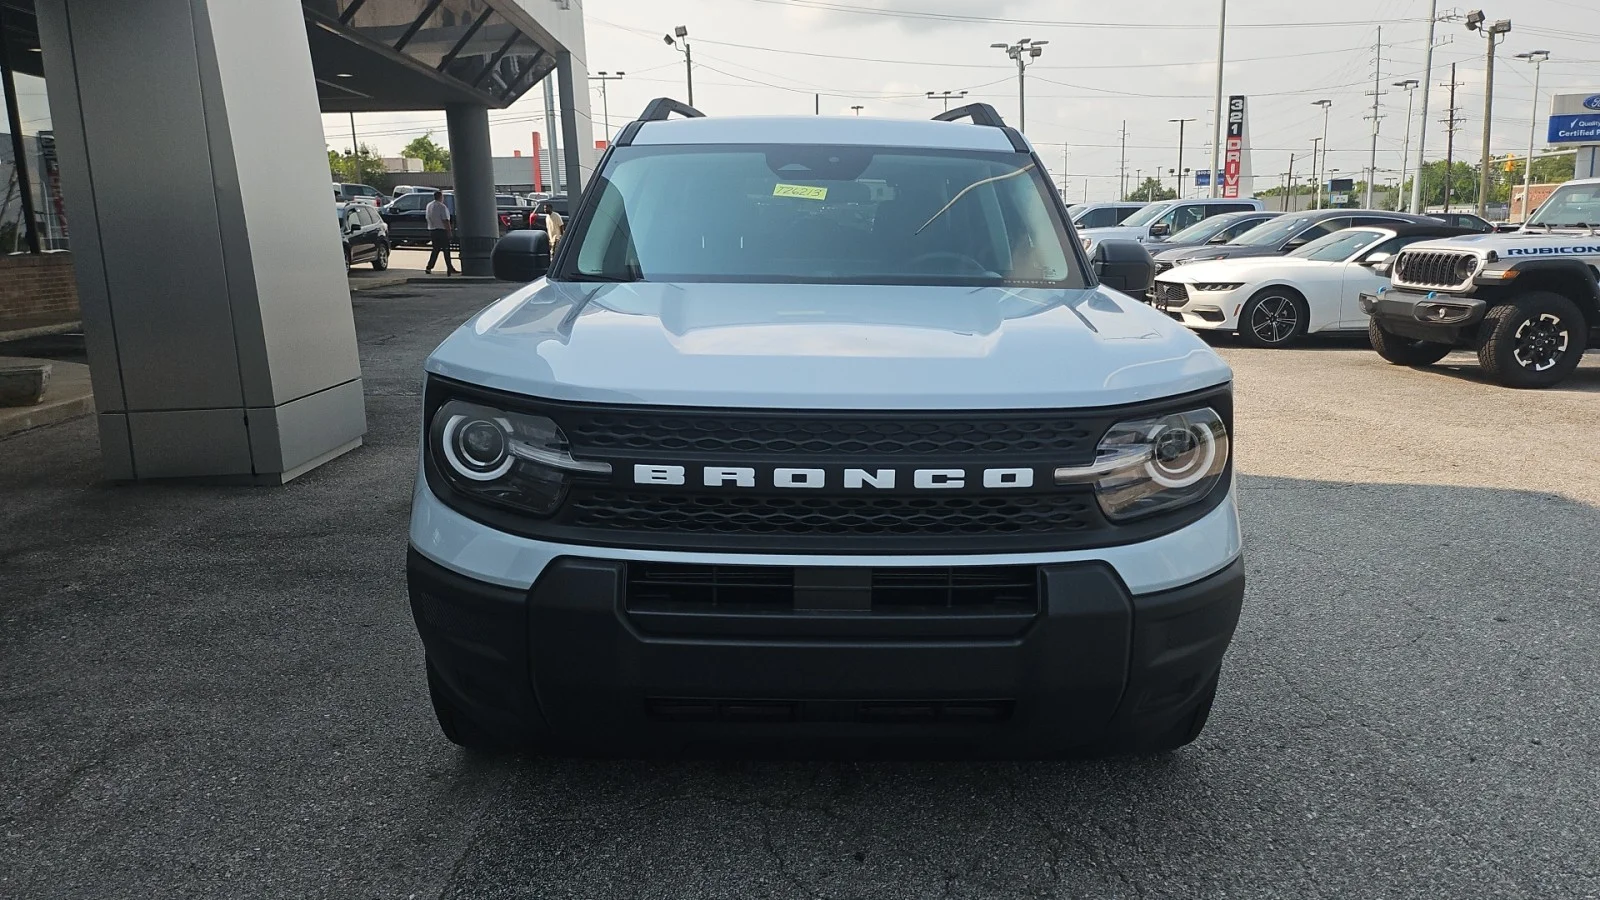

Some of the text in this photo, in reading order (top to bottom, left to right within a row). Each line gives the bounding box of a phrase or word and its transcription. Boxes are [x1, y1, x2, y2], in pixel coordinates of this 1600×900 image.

[1558, 129, 1595, 137] Certified
[1224, 99, 1243, 197] 321 DRIVE
[1507, 246, 1600, 256] RUBICON
[633, 463, 1034, 489] BRONCO
